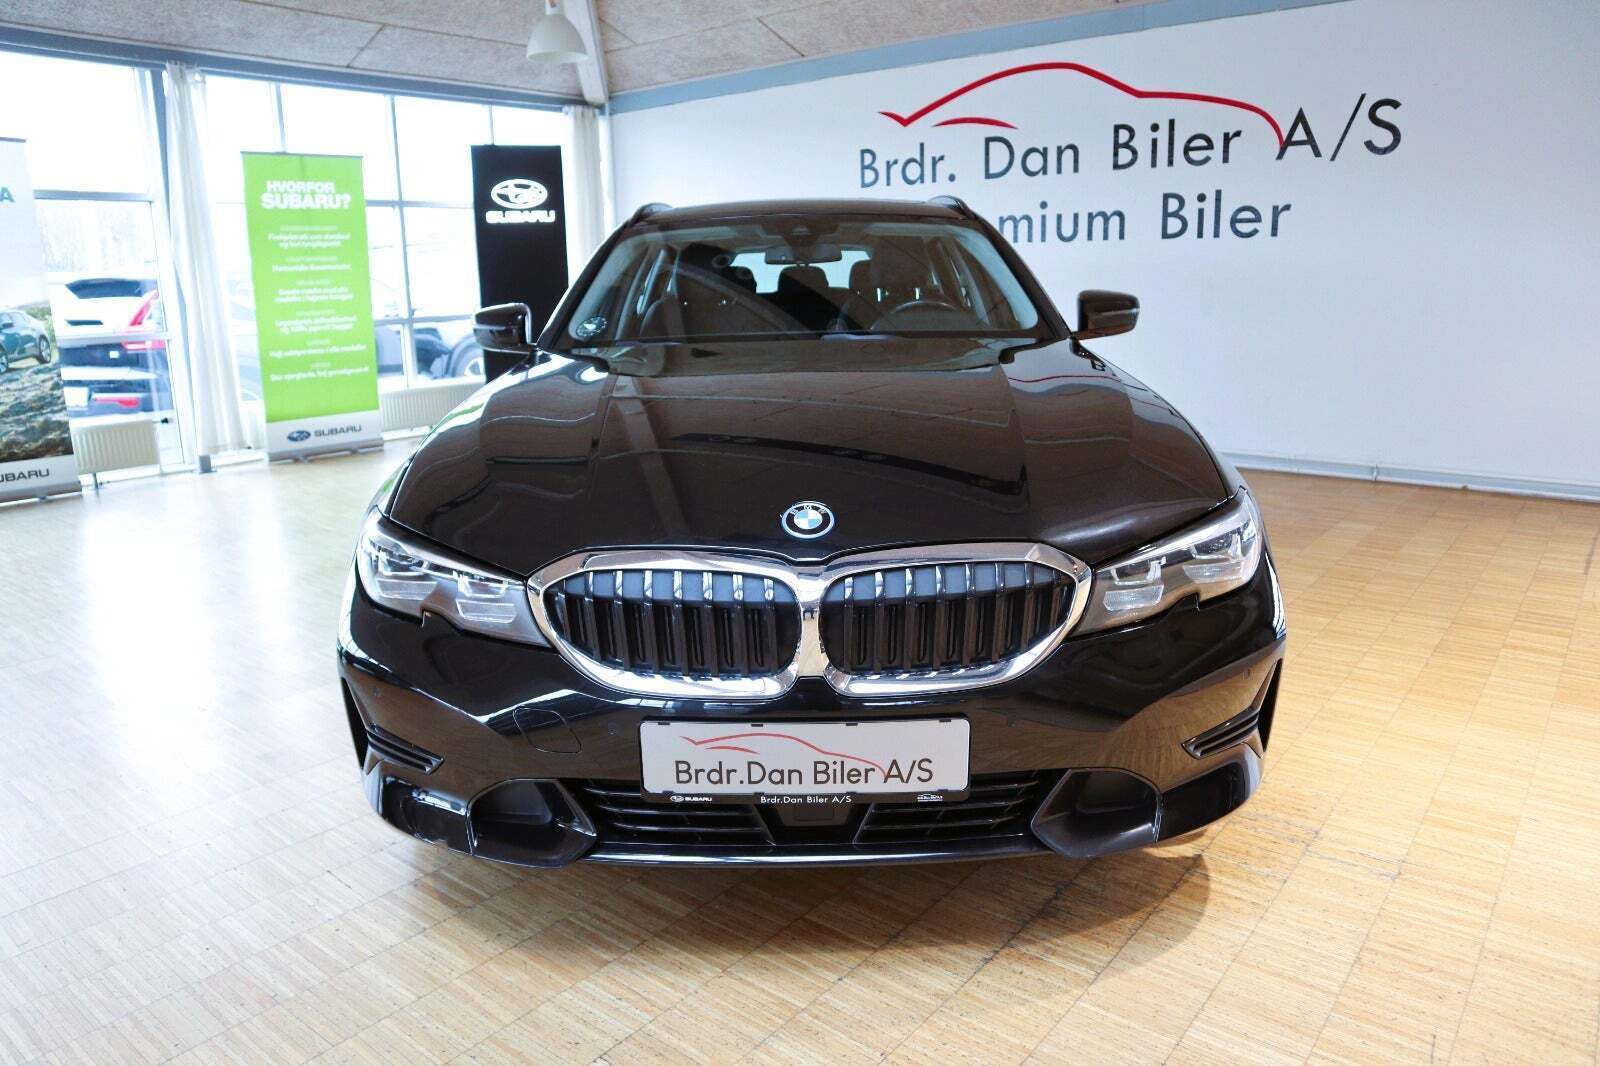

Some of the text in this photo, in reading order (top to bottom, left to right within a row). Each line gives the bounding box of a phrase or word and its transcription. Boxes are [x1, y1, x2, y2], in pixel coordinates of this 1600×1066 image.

[859, 93, 1403, 189] Brdr. Dan Biler A/S
[266, 180, 336, 193] HVORFOR
[260, 192, 352, 209] SUBARU?
[485, 210, 556, 223] SUBARU
[998, 190, 1292, 243] mium Biler
[313, 424, 363, 437] SUBARU
[813, 760, 875, 785] Biler
[883, 758, 934, 784] A/S
[806, 795, 829, 804] Biler
[831, 795, 852, 804] A/S
